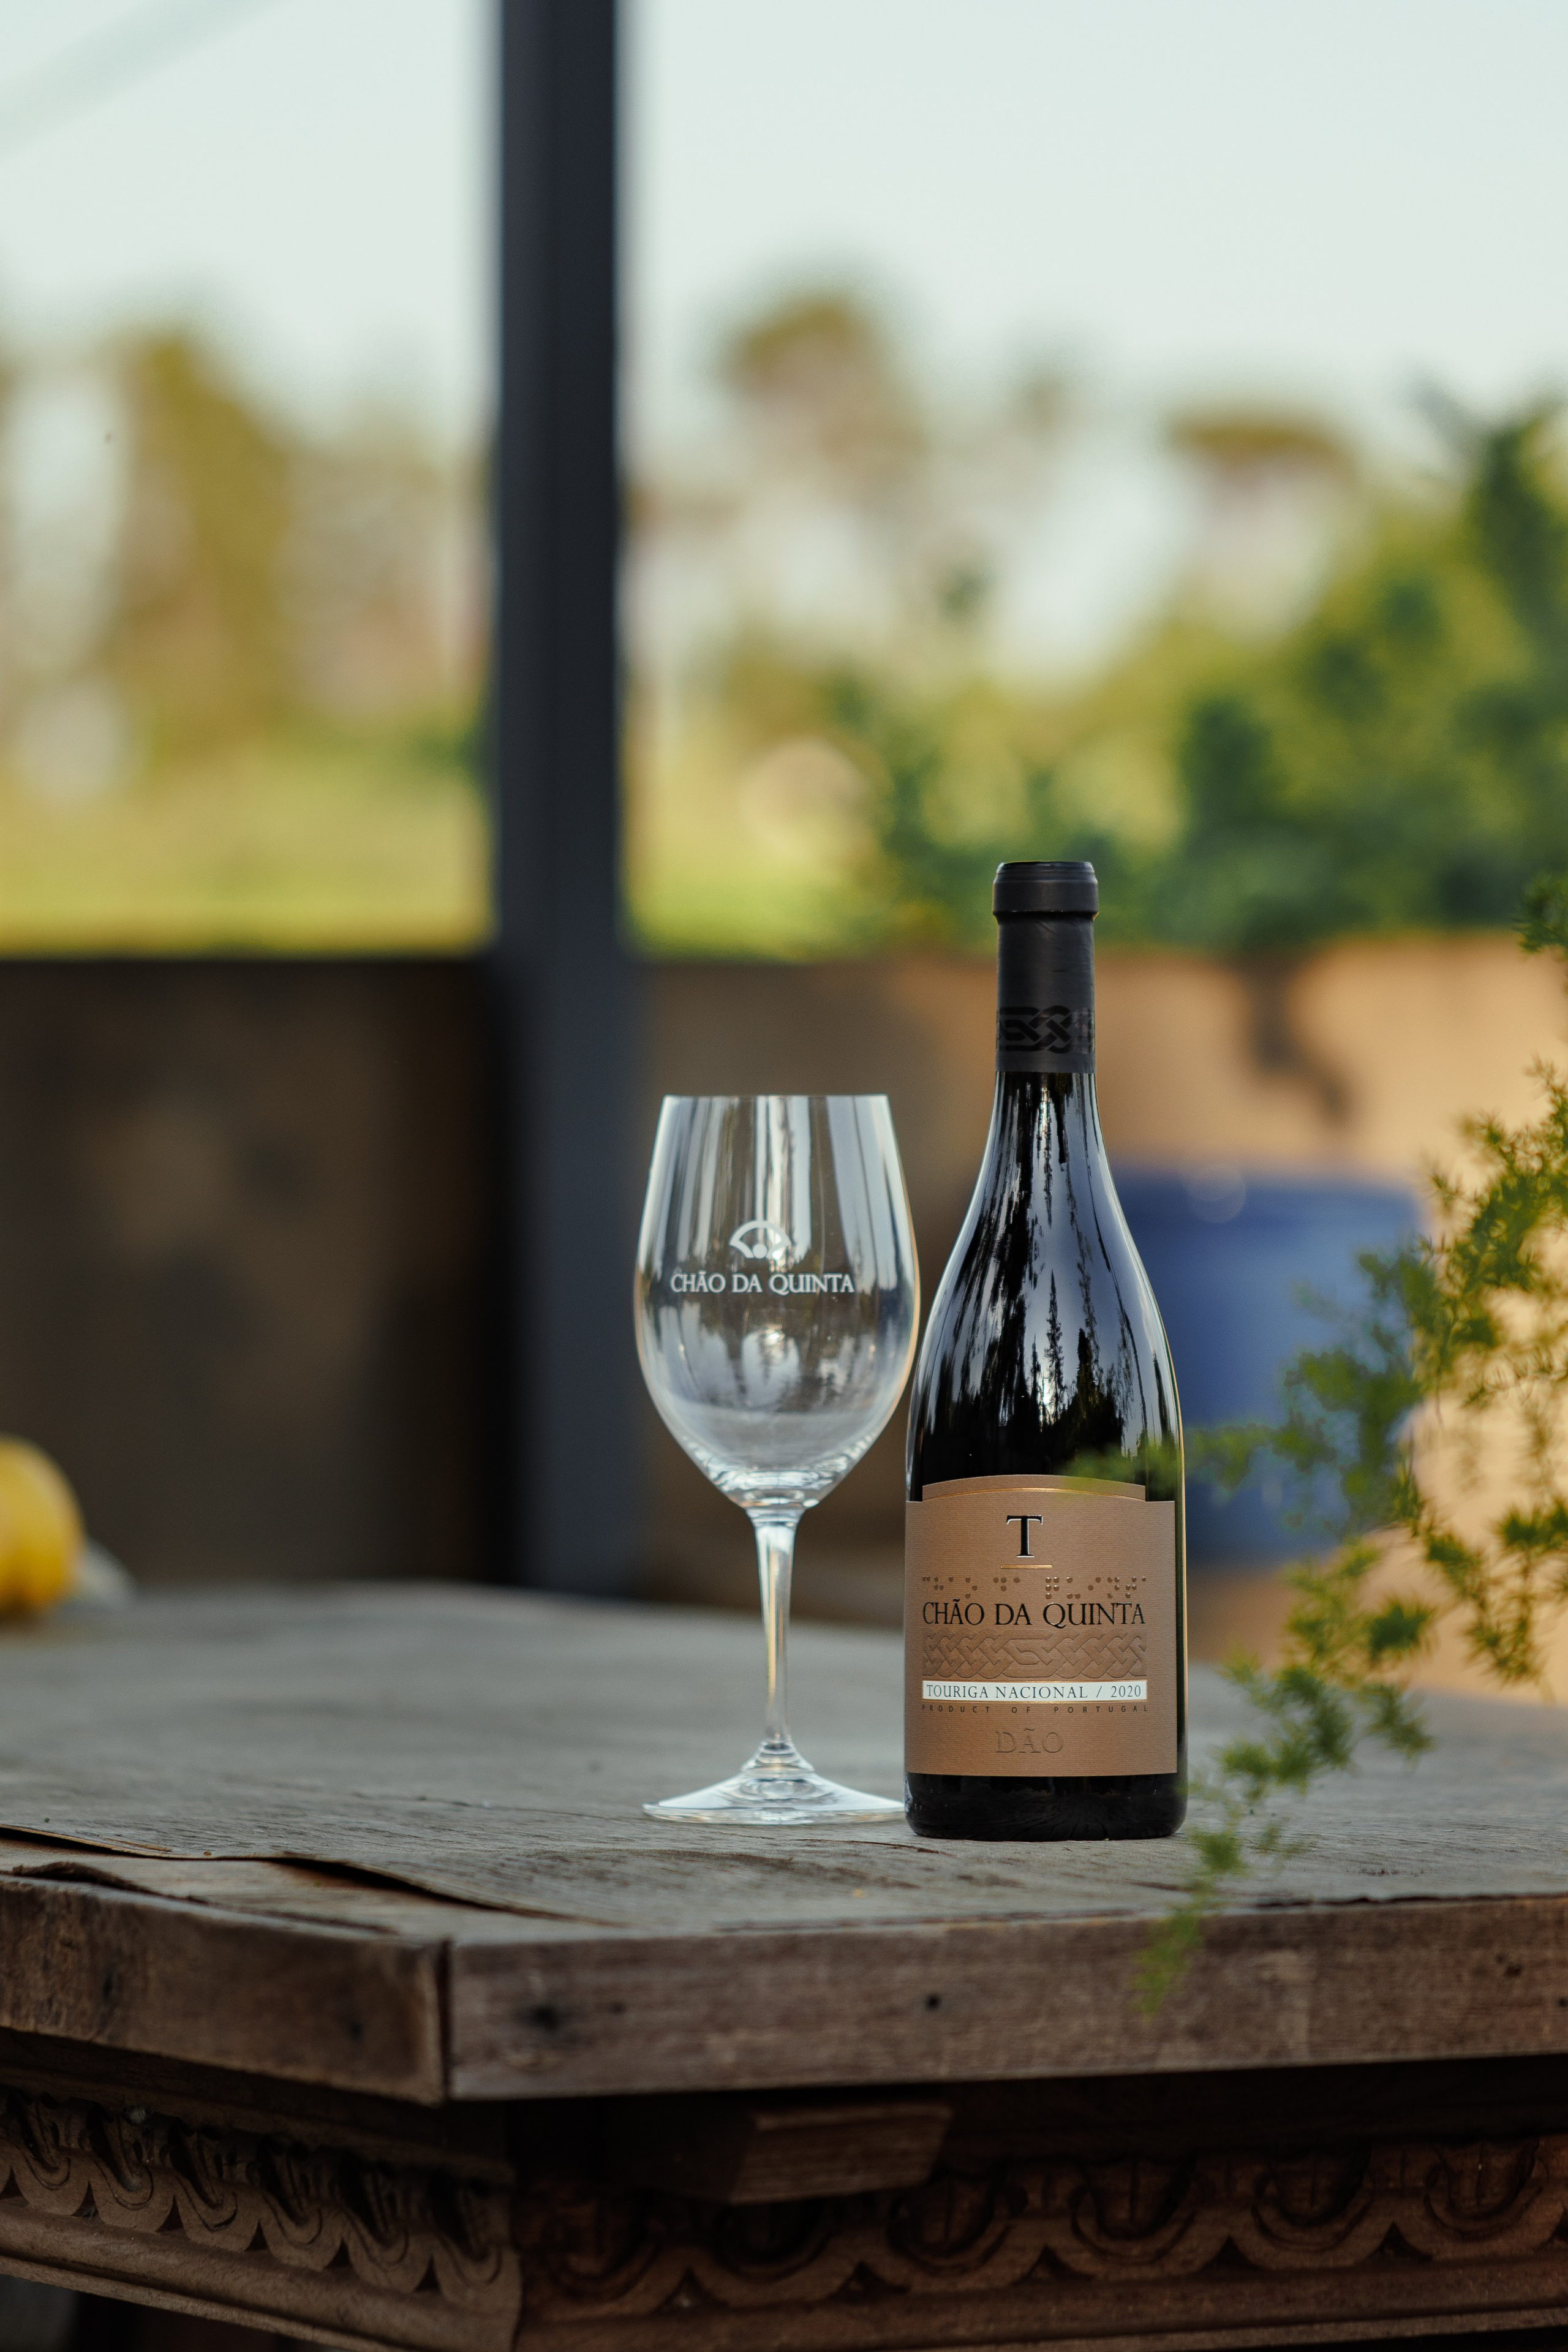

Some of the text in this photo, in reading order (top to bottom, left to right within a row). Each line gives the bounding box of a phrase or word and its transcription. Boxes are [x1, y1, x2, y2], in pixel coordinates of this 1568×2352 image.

[671, 1271, 855, 1296] CHÃO DA QUINTA
[1006, 1515, 1043, 1558] T
[922, 1599, 1146, 1629] CHÃO DA QUINTA
[927, 1684, 989, 1698] TOURIGA
[995, 1686, 1088, 1699] NACIONAL
[1110, 1684, 1142, 1698] 2020
[922, 1705, 990, 1713] PRODUCT
[1054, 1705, 1148, 1713] PORTUGAL
[995, 1728, 1065, 1754] DÃO
